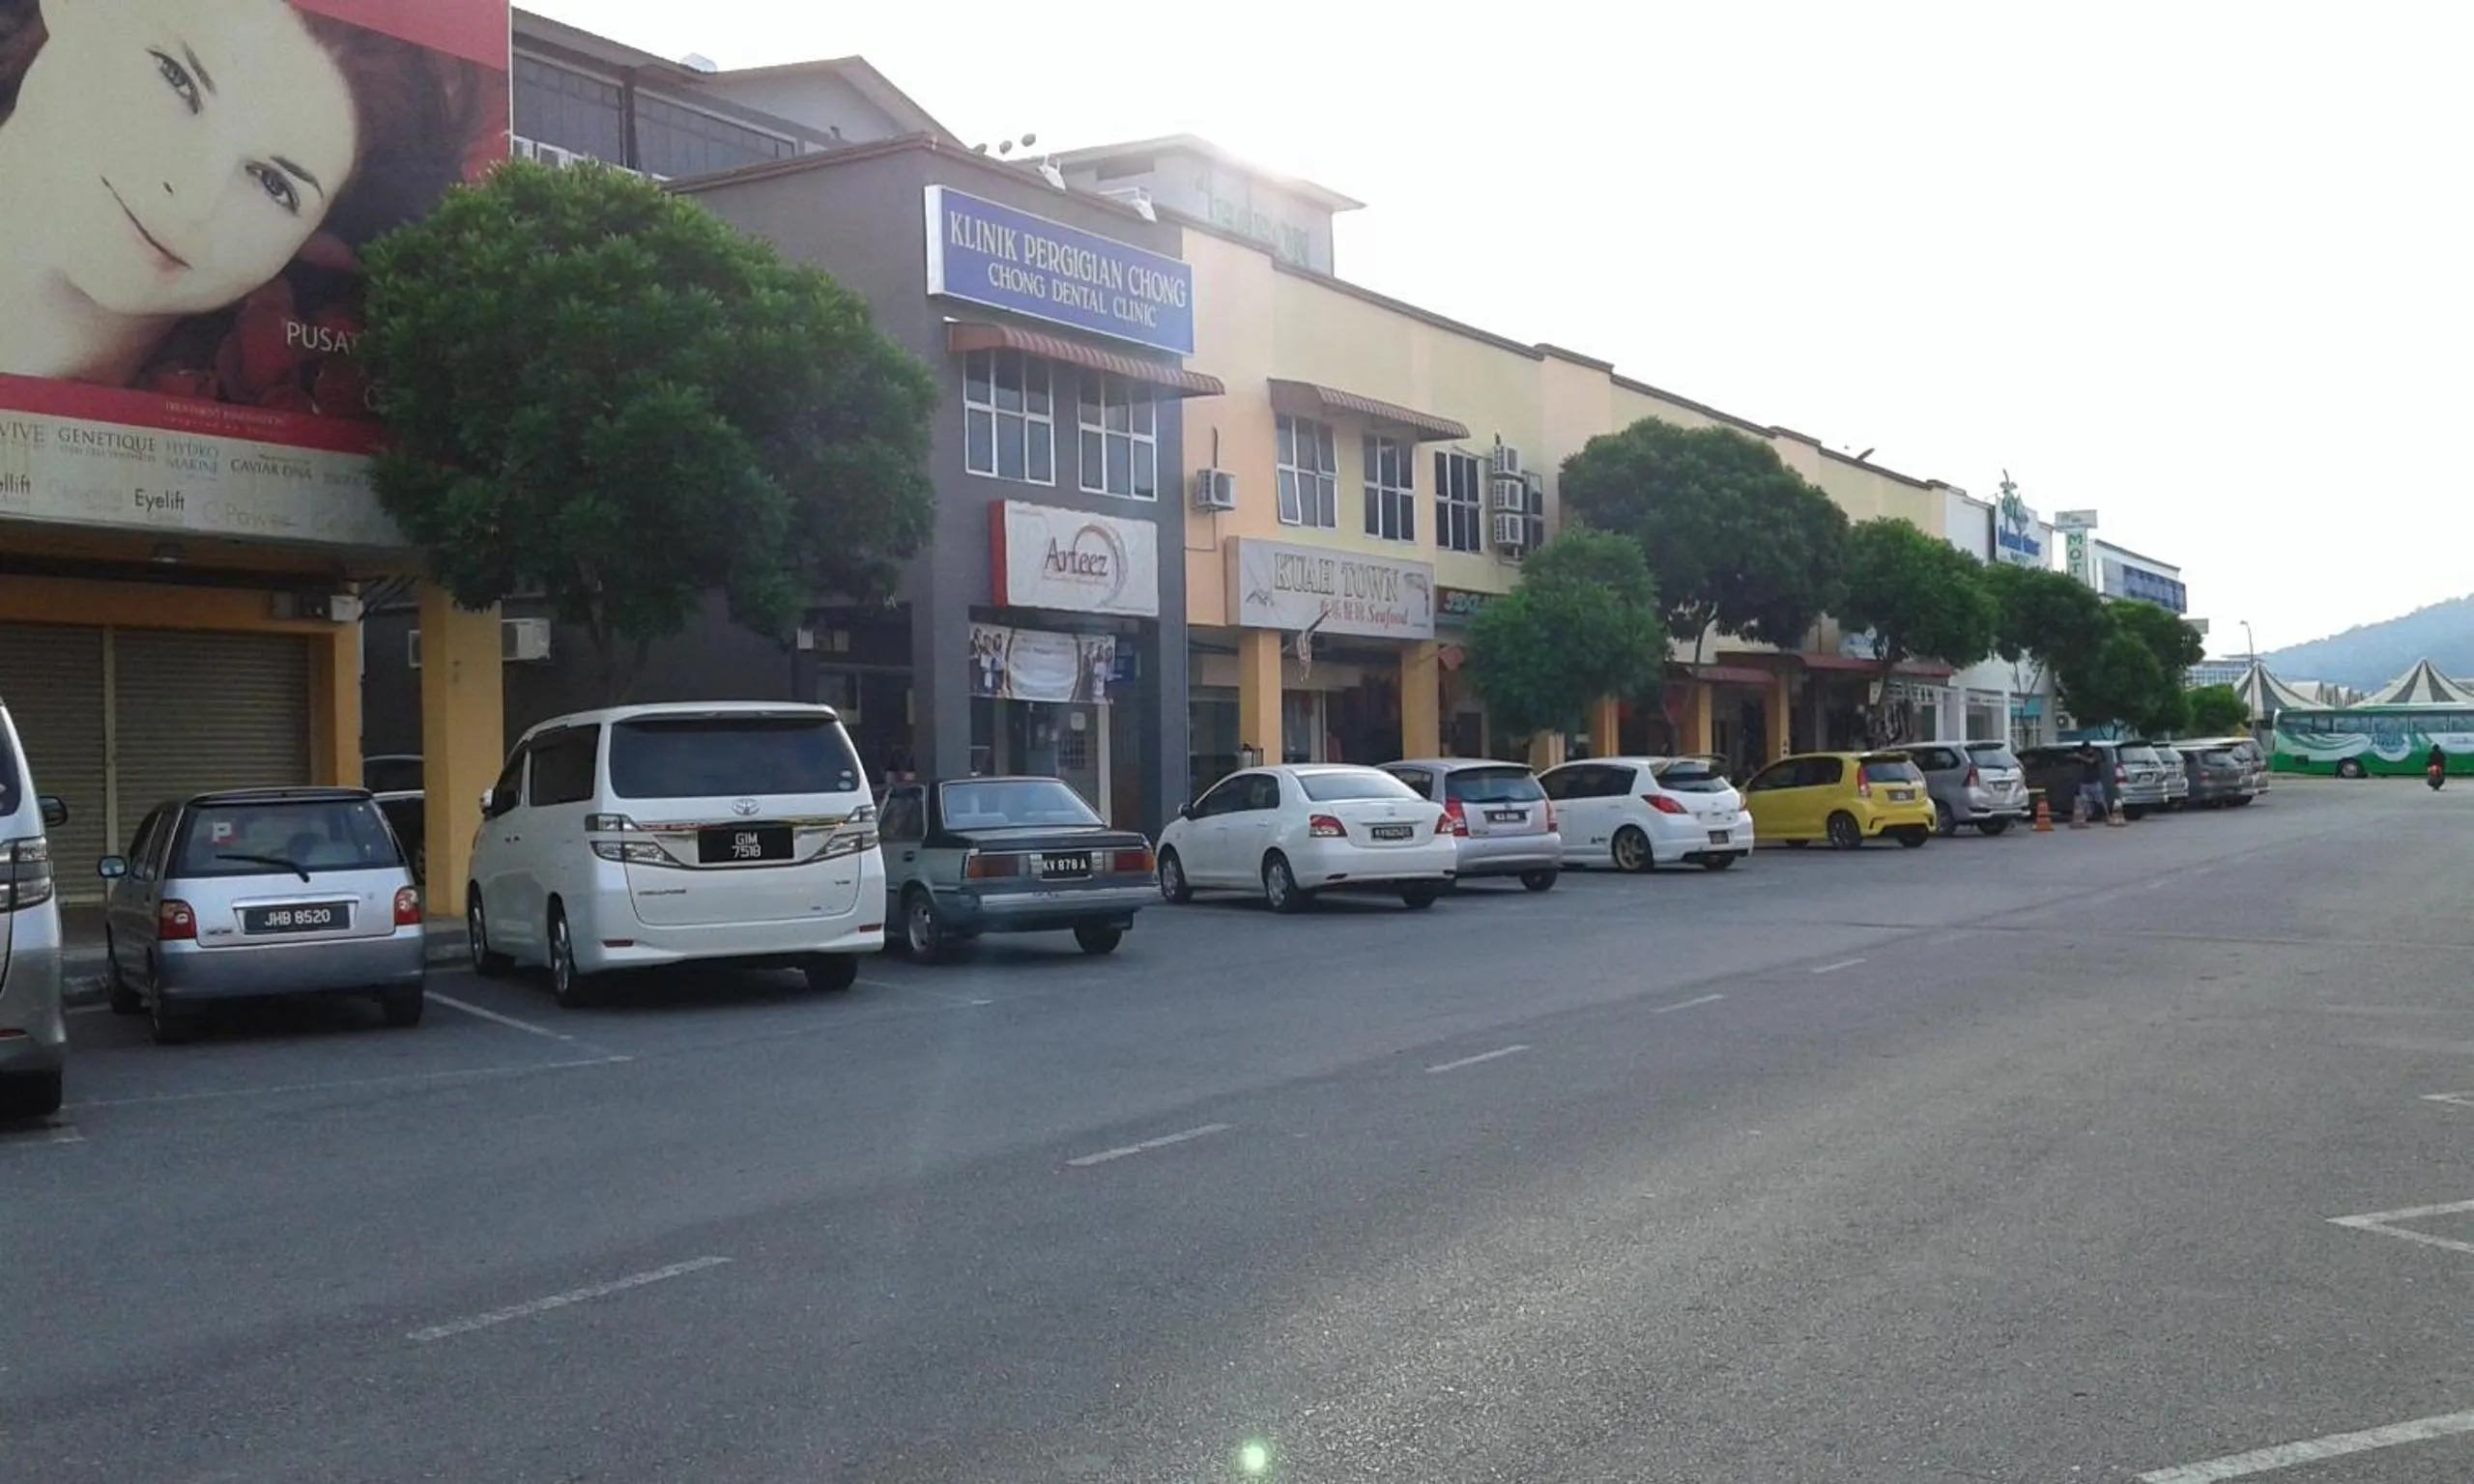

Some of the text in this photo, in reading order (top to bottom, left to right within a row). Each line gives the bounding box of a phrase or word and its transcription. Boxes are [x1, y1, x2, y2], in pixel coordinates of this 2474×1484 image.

[950, 211, 1186, 308] KLINIK PERGIGIAN CHONG
[988, 263, 1157, 328] CHONG DENTAL CLINIC
[58, 427, 157, 452] GENETIQUE
[134, 487, 185, 512] Eyelift
[1045, 537, 1108, 576] Arteez
[1274, 553, 1336, 595] KUAH
[1341, 561, 1399, 602] TOWN
[1367, 604, 1408, 629] Seafood
[264, 908, 331, 928] JHB 8520
